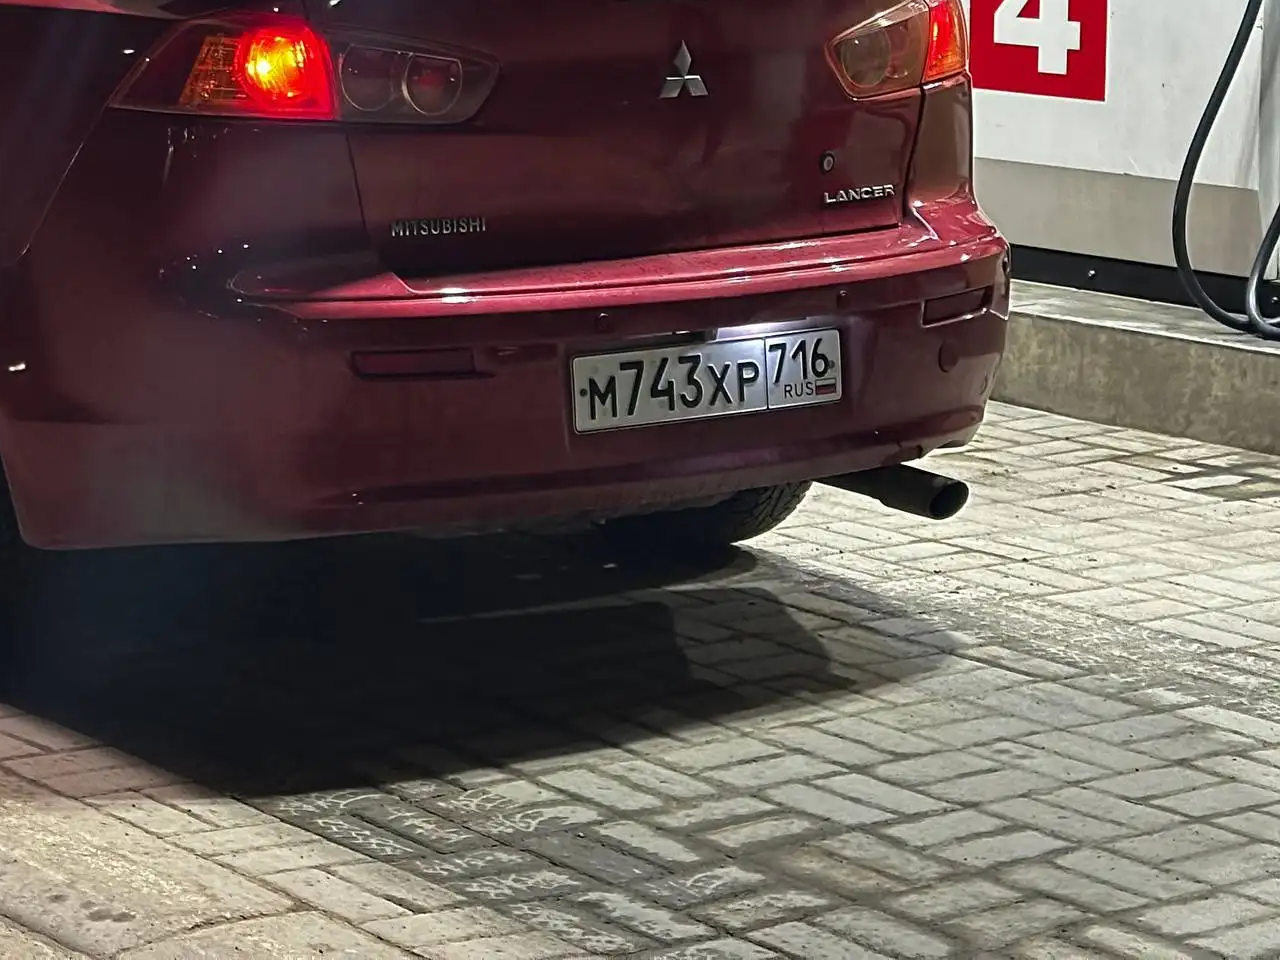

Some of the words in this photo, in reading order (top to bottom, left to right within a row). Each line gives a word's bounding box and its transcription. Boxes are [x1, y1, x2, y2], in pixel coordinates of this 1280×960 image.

[823, 183, 896, 205] LANCER
[390, 217, 487, 237] MITSUBISHI
[767, 337, 831, 385] 716
[783, 382, 815, 399] RUS
